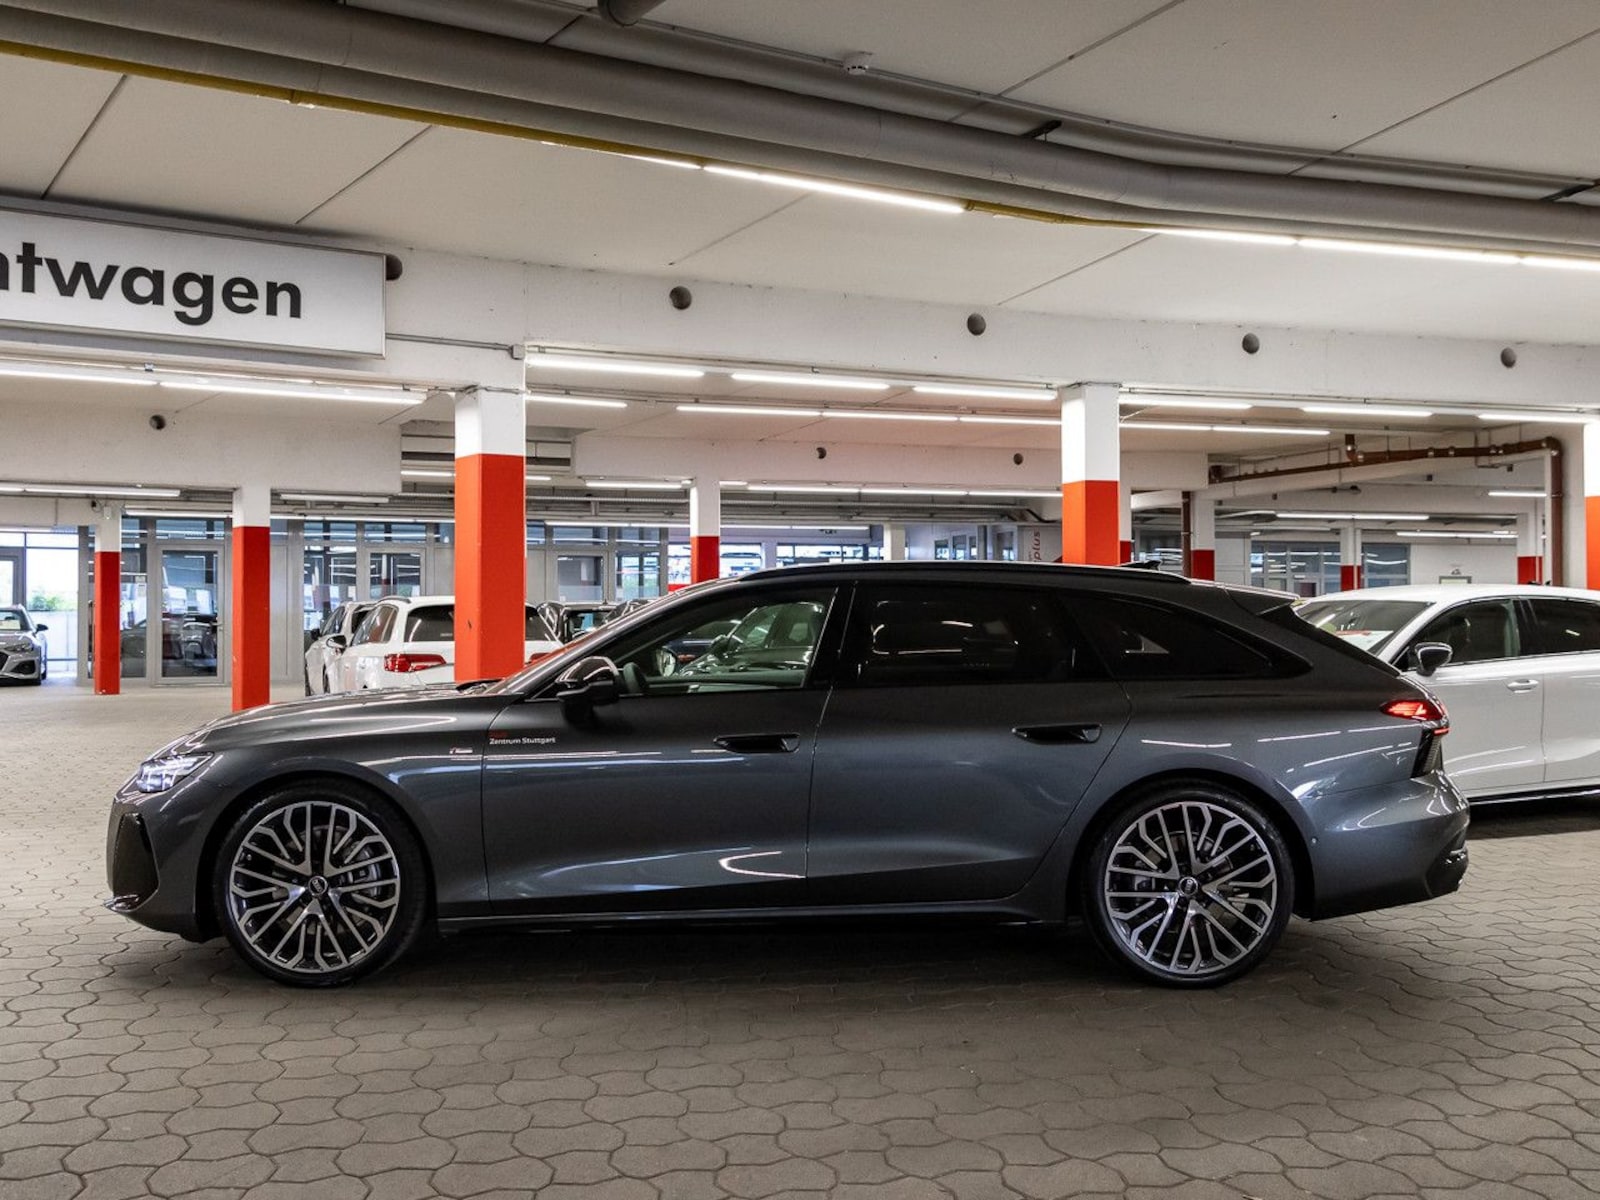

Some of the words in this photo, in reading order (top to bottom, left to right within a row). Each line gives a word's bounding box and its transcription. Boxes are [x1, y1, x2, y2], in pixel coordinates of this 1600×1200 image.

[0, 242, 302, 326] twagen
[489, 737, 520, 745] Zentrum
[522, 737, 556, 745] Stuttgart
